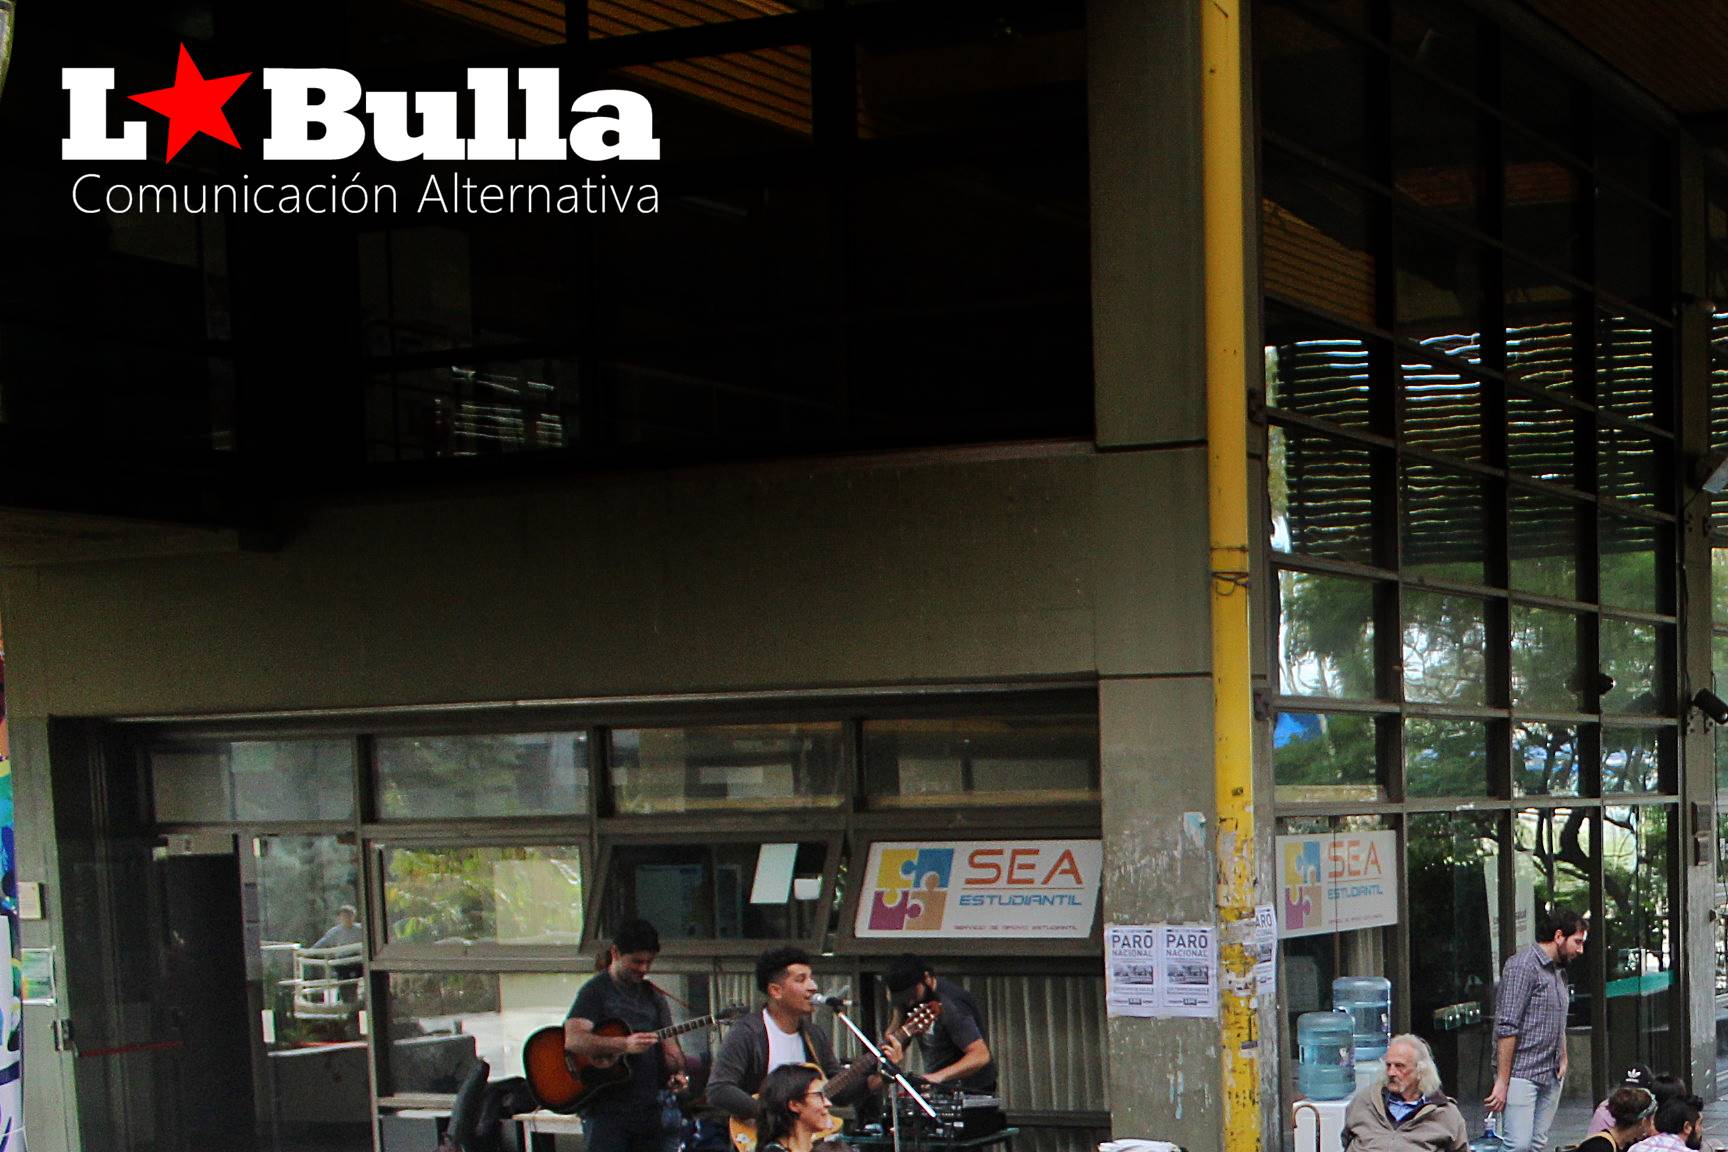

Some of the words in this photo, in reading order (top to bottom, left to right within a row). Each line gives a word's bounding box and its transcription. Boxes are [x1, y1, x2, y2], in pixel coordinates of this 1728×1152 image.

[965, 848, 1083, 885] SEA
[1327, 840, 1382, 878] SEA
[959, 894, 1082, 906] ESTUDIANTIL
[1112, 934, 1153, 949] PARO
[1166, 934, 1208, 949] PARO
[1112, 949, 1153, 957] NACIONAL
[1166, 949, 1208, 957] NACIONAL
